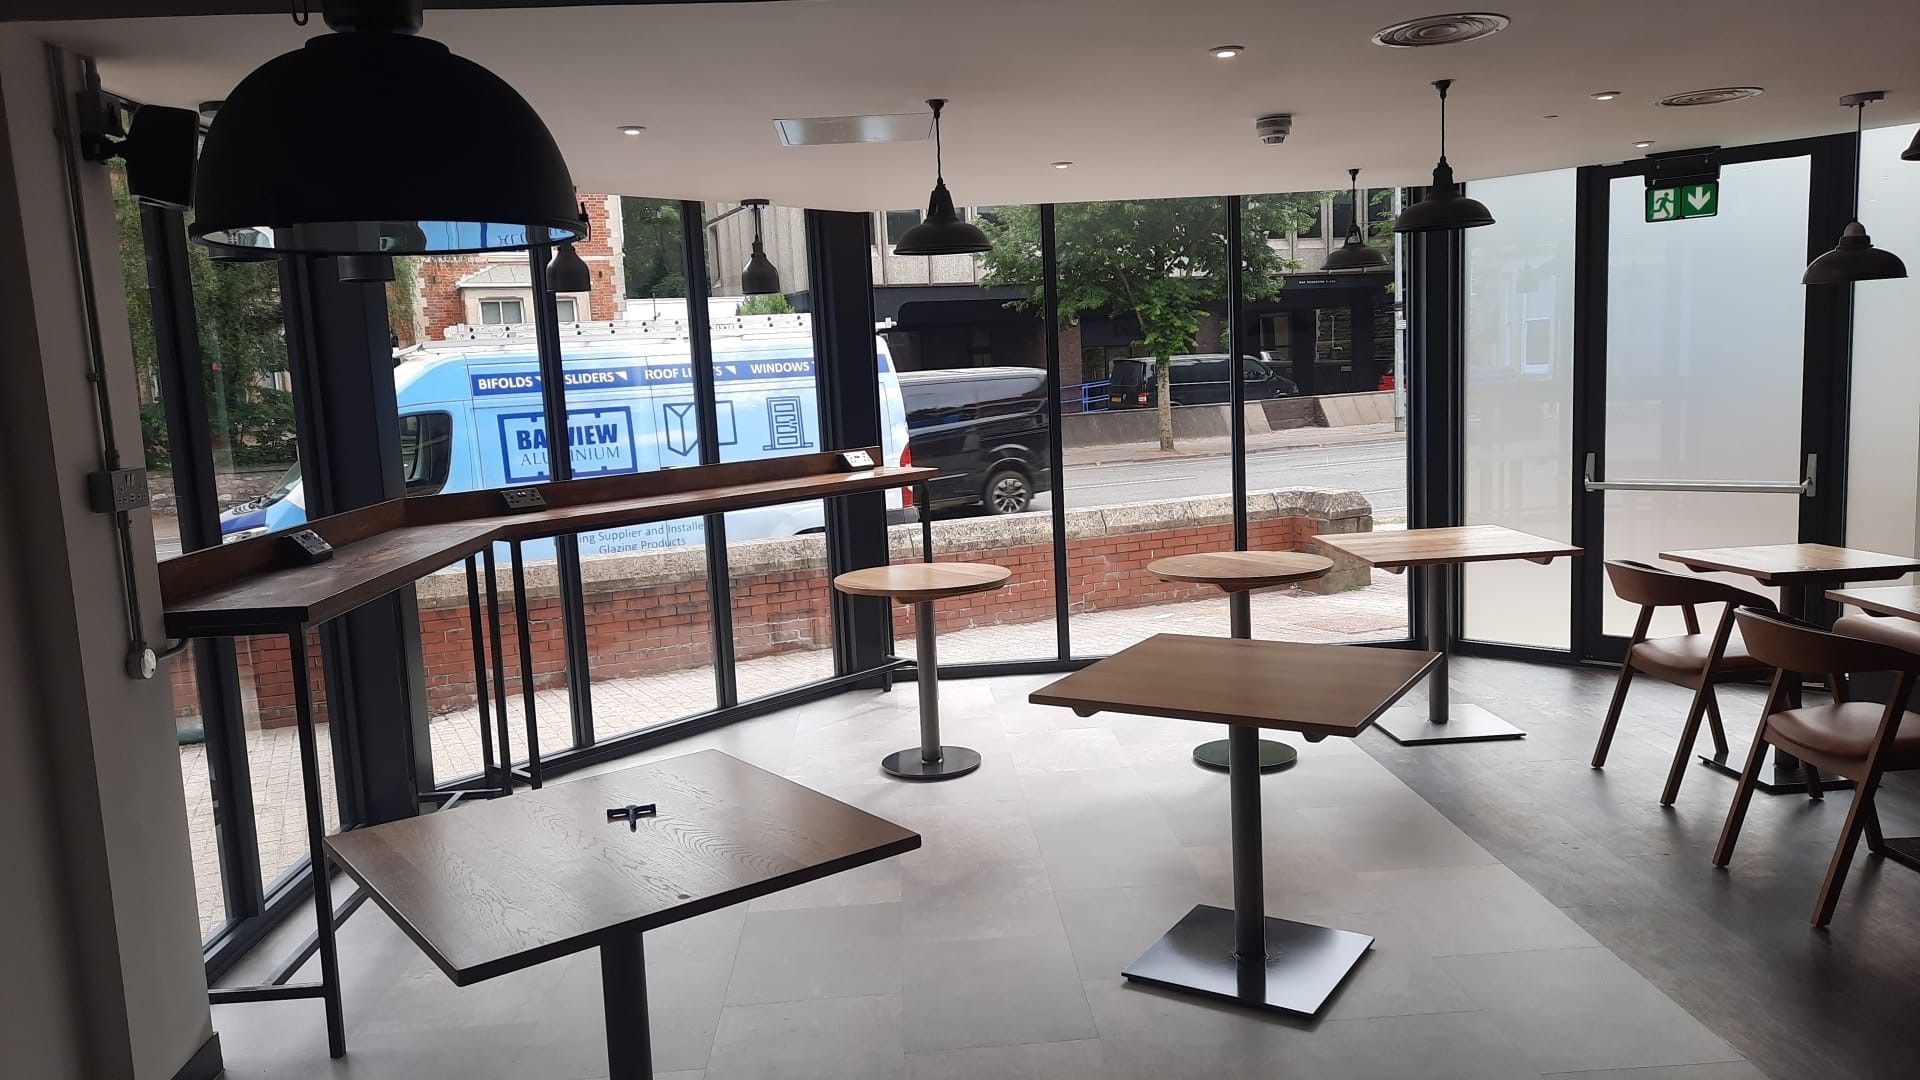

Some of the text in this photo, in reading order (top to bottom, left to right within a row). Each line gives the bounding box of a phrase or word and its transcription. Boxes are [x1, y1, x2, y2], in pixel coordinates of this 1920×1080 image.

[478, 361, 810, 390] BIFOLDS SLIDERS ROOF LIS WINDOWS
[516, 424, 618, 450] BAVIEW
[521, 446, 620, 466] ALUINIUM
[598, 528, 642, 542] Supplier
[645, 525, 664, 536] and
[668, 521, 704, 533] Installe
[641, 537, 686, 549] Products
